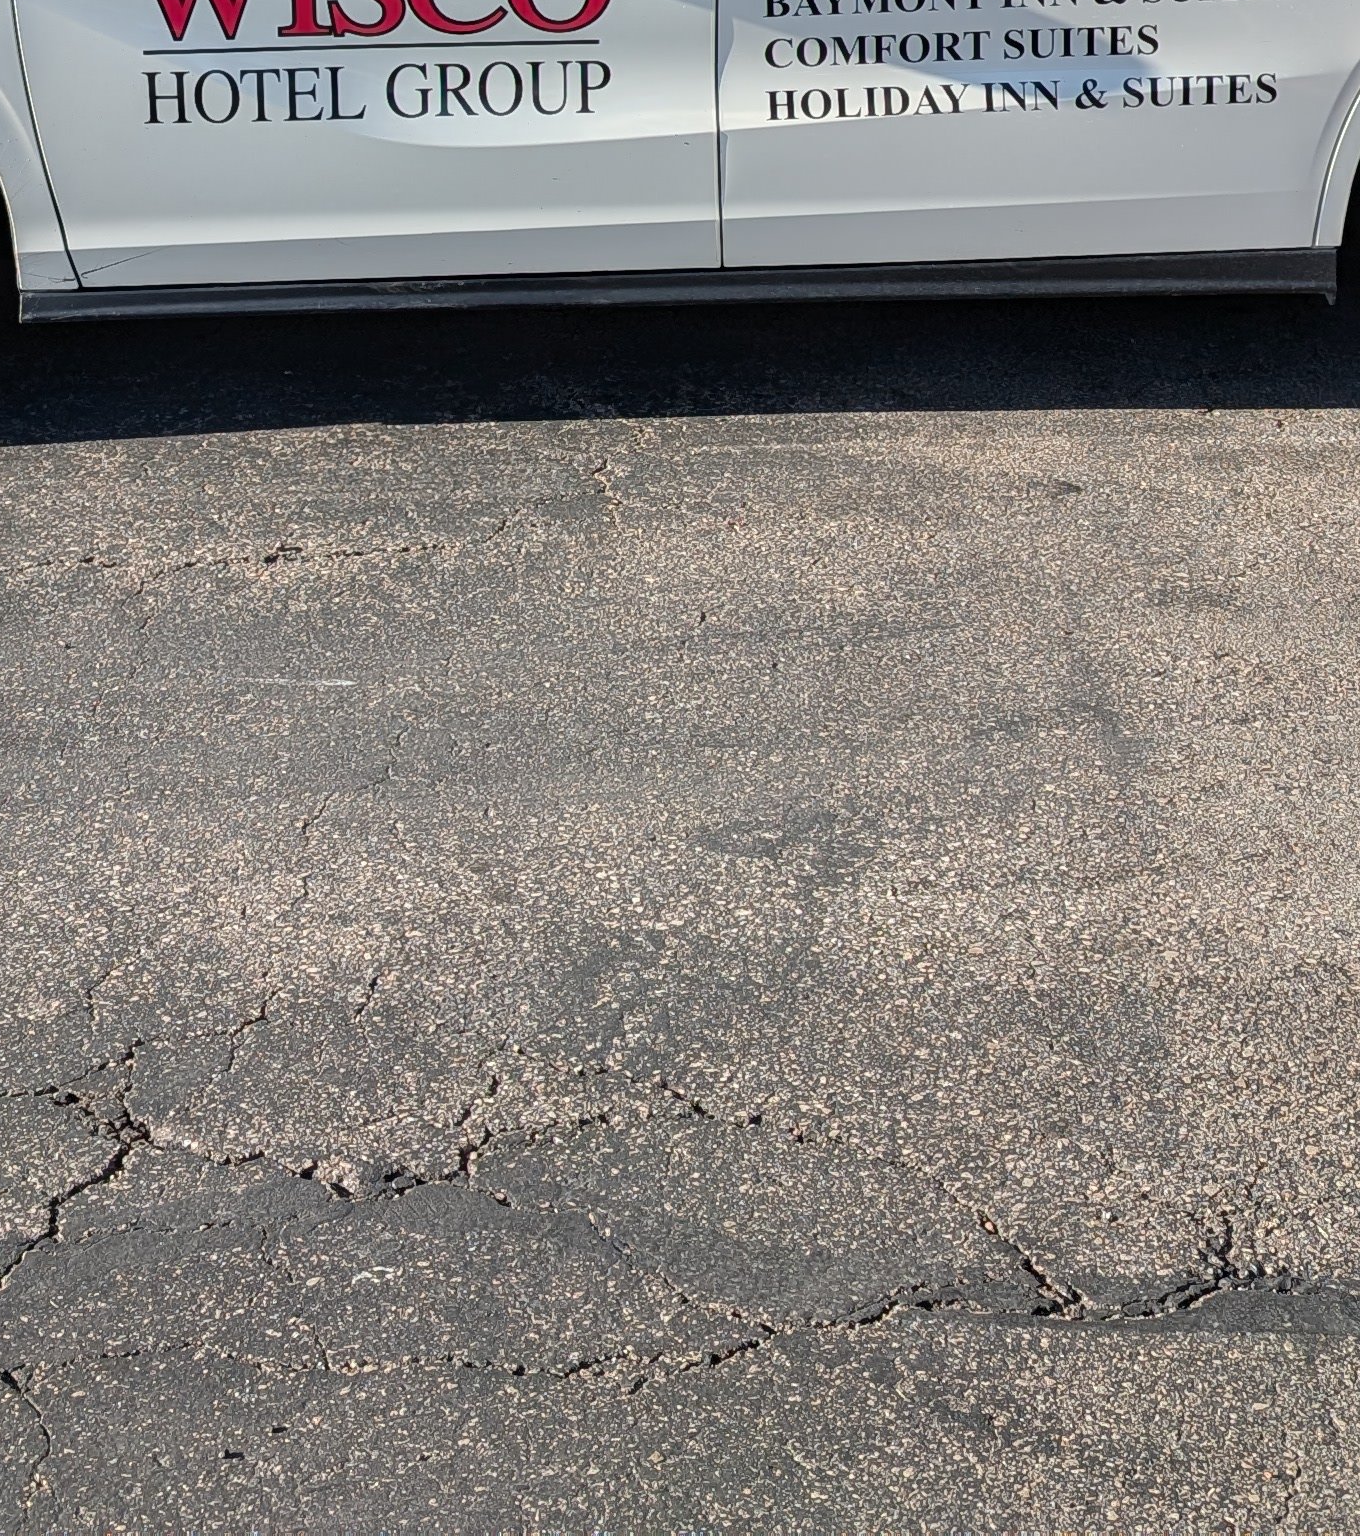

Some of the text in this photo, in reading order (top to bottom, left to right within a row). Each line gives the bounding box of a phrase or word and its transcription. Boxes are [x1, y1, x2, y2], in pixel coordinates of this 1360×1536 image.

[765, 26, 1158, 67] COMFORT SUITES
[142, 61, 610, 123] HOTEL GROUP
[767, 75, 1276, 120] HOLIDAY INN & SUITES
